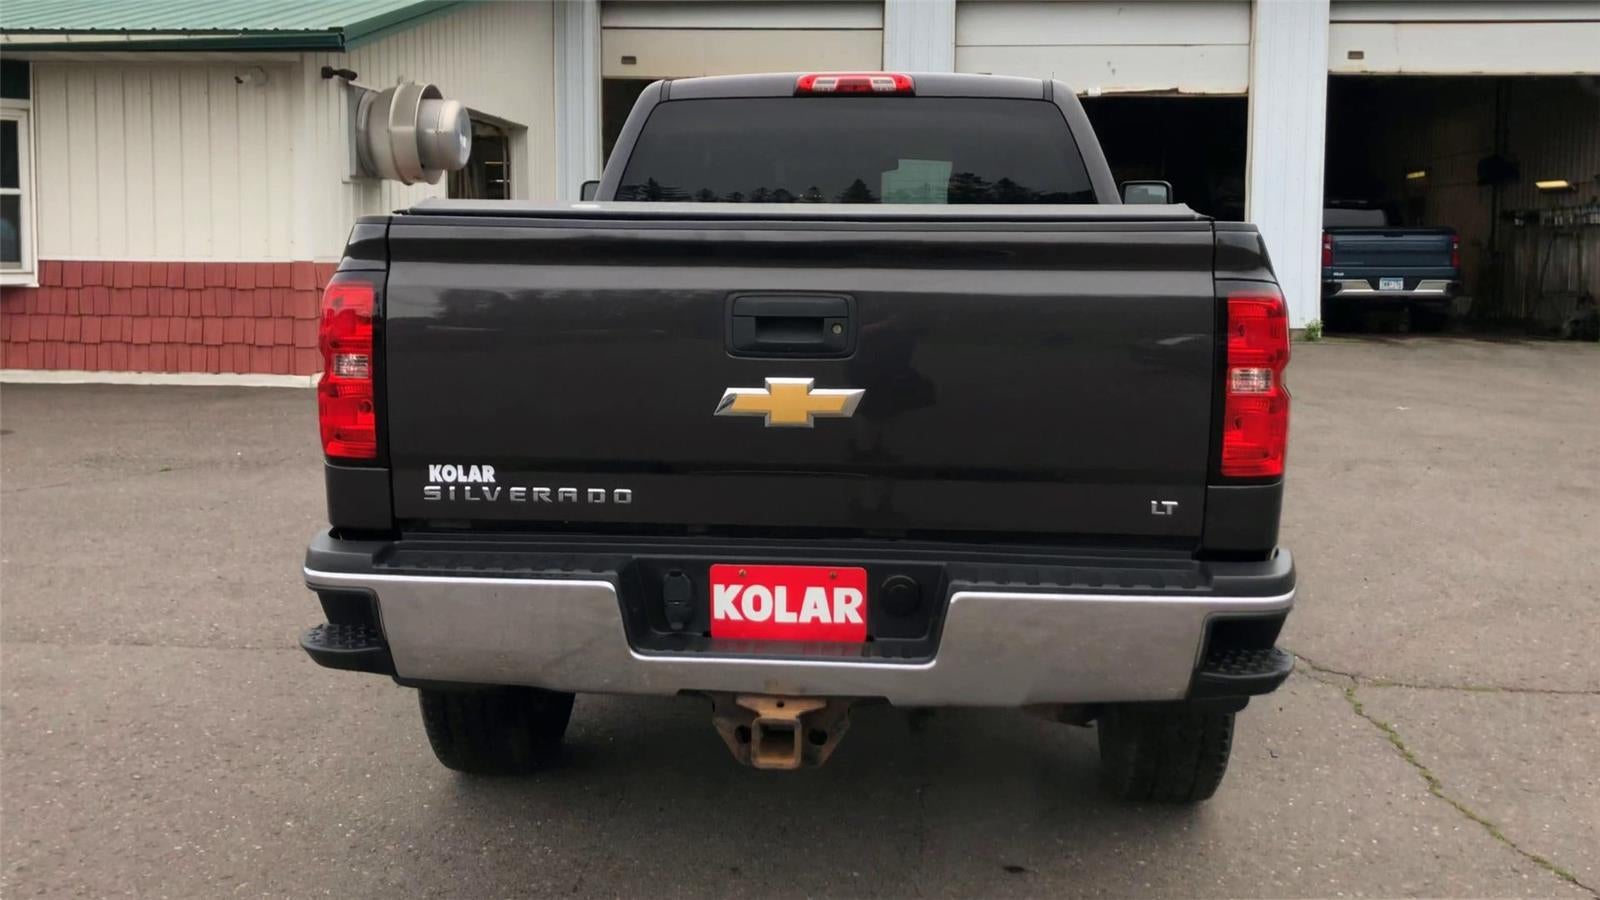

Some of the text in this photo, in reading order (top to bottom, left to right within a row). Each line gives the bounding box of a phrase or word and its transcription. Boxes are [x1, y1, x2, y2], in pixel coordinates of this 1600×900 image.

[429, 464, 496, 483] KOLAR
[423, 486, 632, 504] SILVERADO
[1151, 500, 1179, 515] LT
[713, 583, 864, 624] KOLAR
